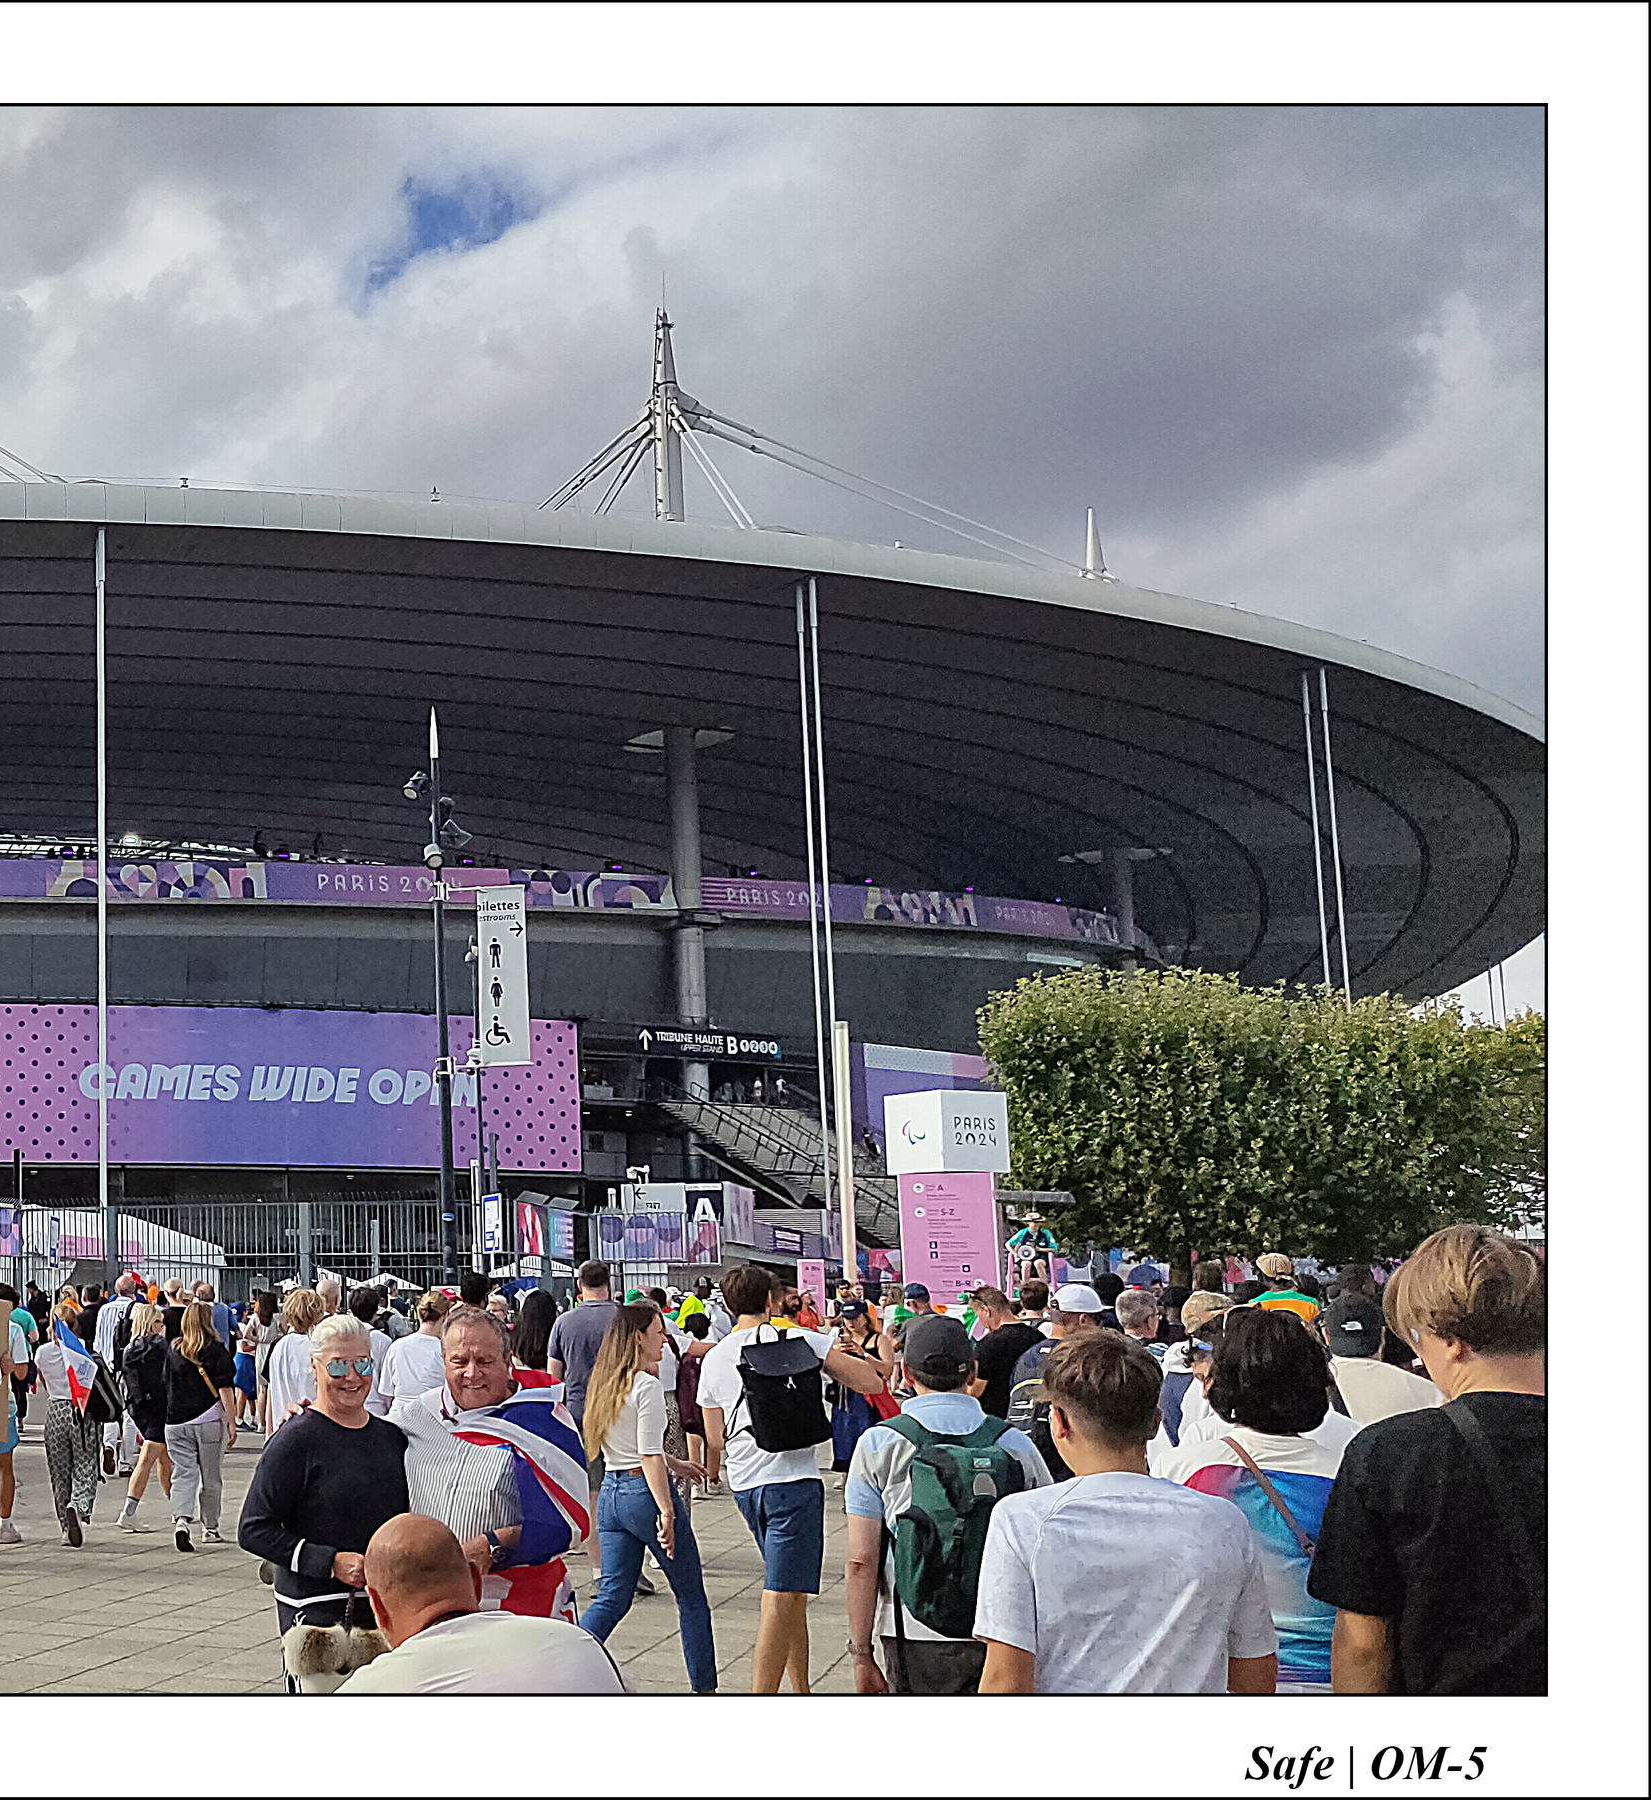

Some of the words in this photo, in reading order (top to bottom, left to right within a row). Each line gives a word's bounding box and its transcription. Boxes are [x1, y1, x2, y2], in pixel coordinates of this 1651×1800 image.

[400, 875, 462, 894] 204
[655, 1031, 693, 1043] TRIBUNE
[695, 1034, 724, 1046] HAUTE
[727, 1036, 738, 1055] B
[79, 1063, 241, 1100] GAMES
[248, 1065, 360, 1103] WIDE
[953, 1116, 996, 1131] PARIS
[955, 1132, 997, 1146] 2024
[693, 1198, 718, 1222] A
[941, 1208, 955, 1216] S-Z
